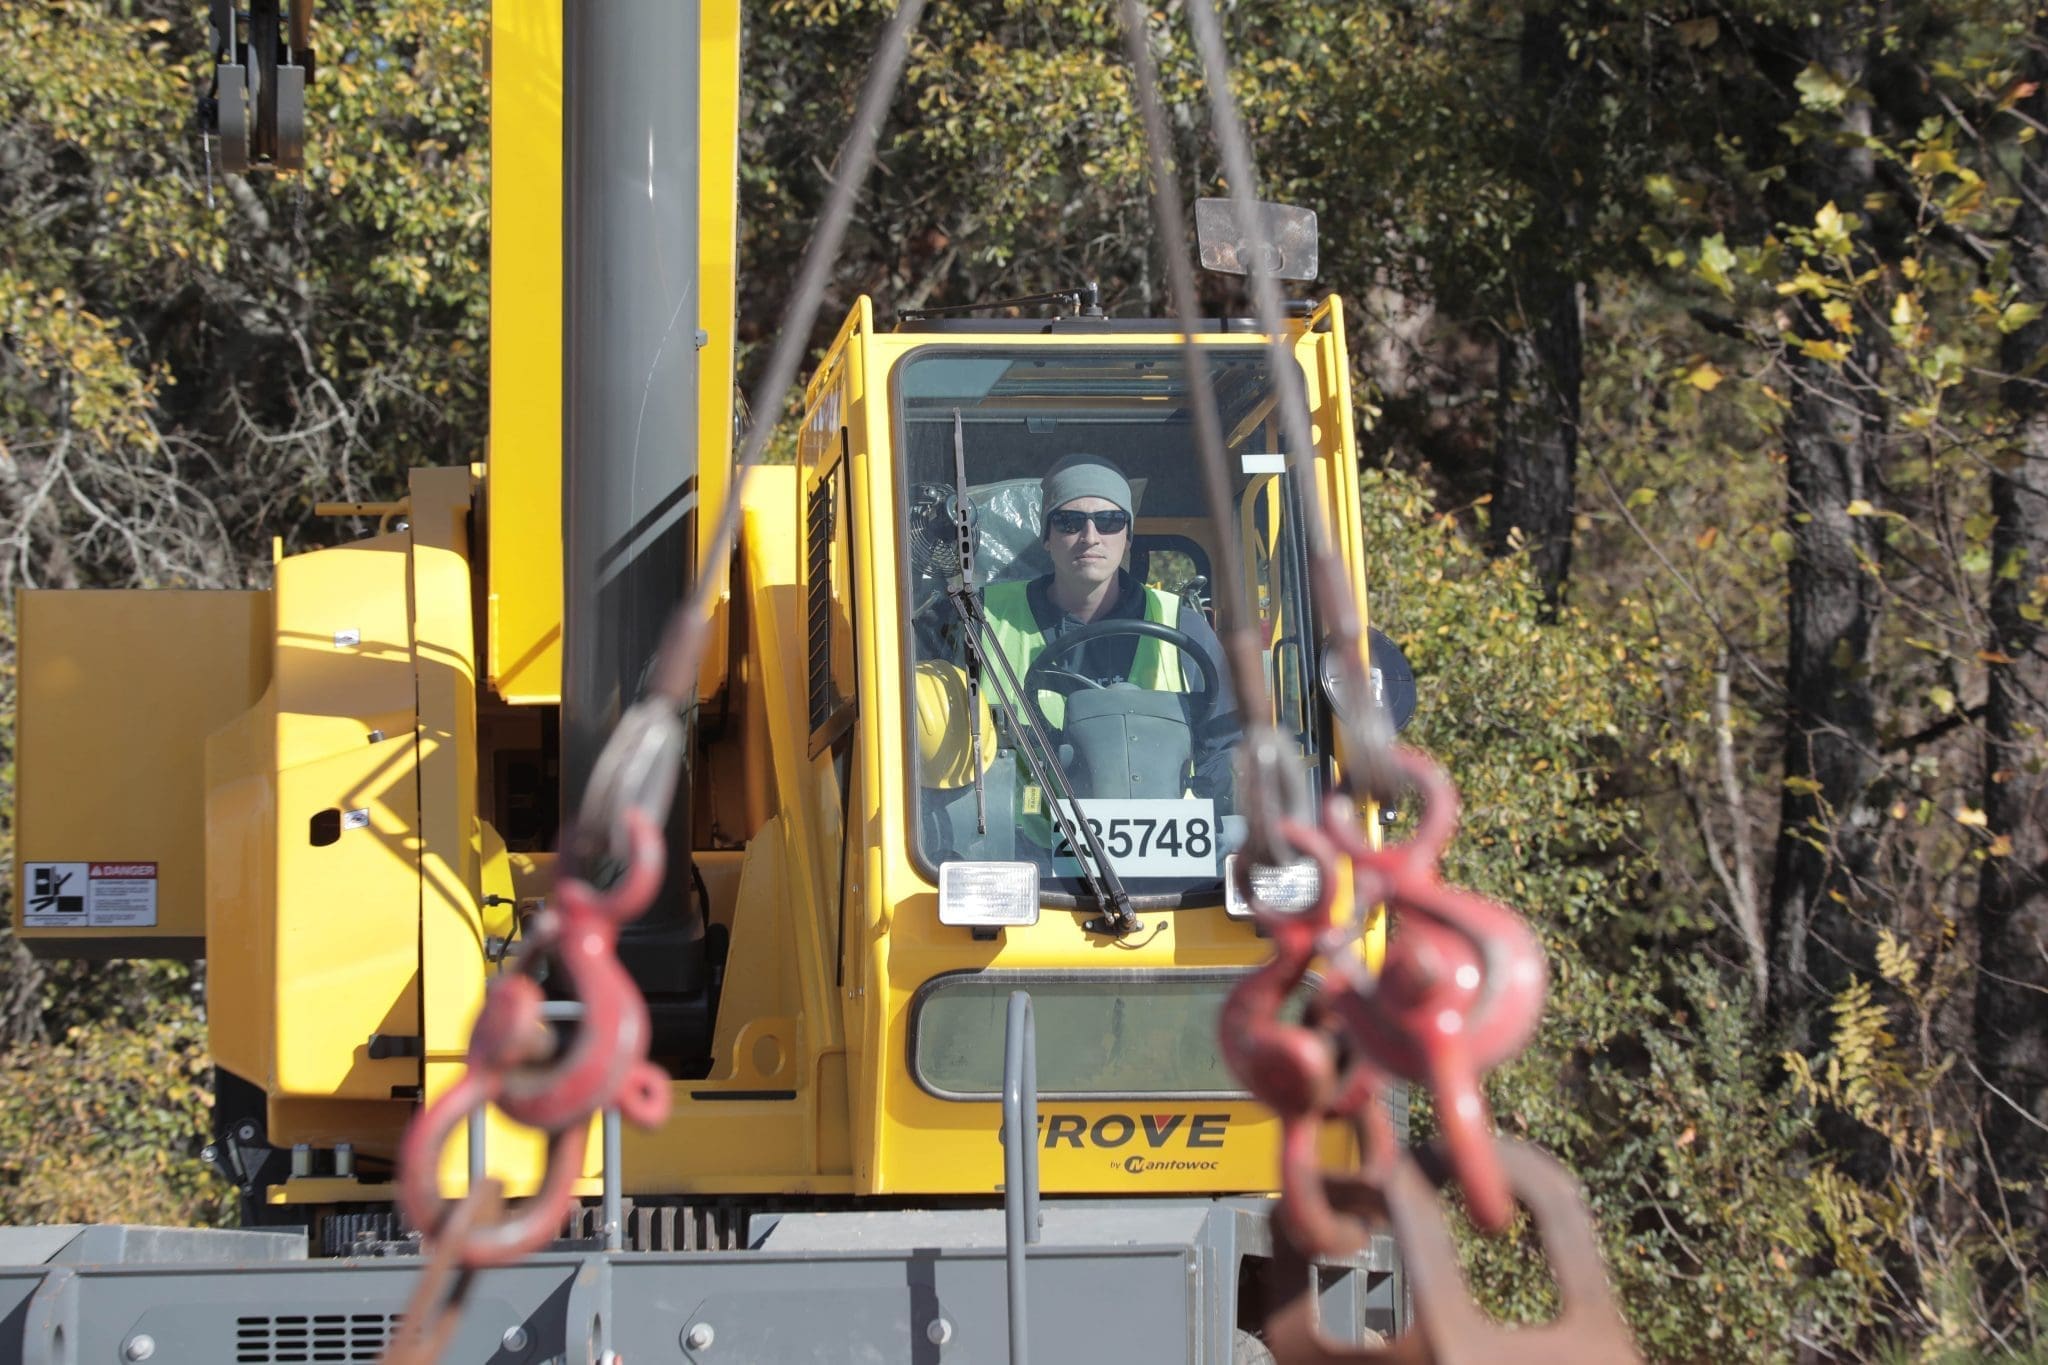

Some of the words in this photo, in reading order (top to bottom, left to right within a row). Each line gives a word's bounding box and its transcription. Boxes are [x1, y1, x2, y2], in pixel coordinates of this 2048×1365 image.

[103, 865, 155, 876] DANGER
[1110, 1159, 1121, 1170] by
[1124, 1155, 1219, 1174] Manitowoc
